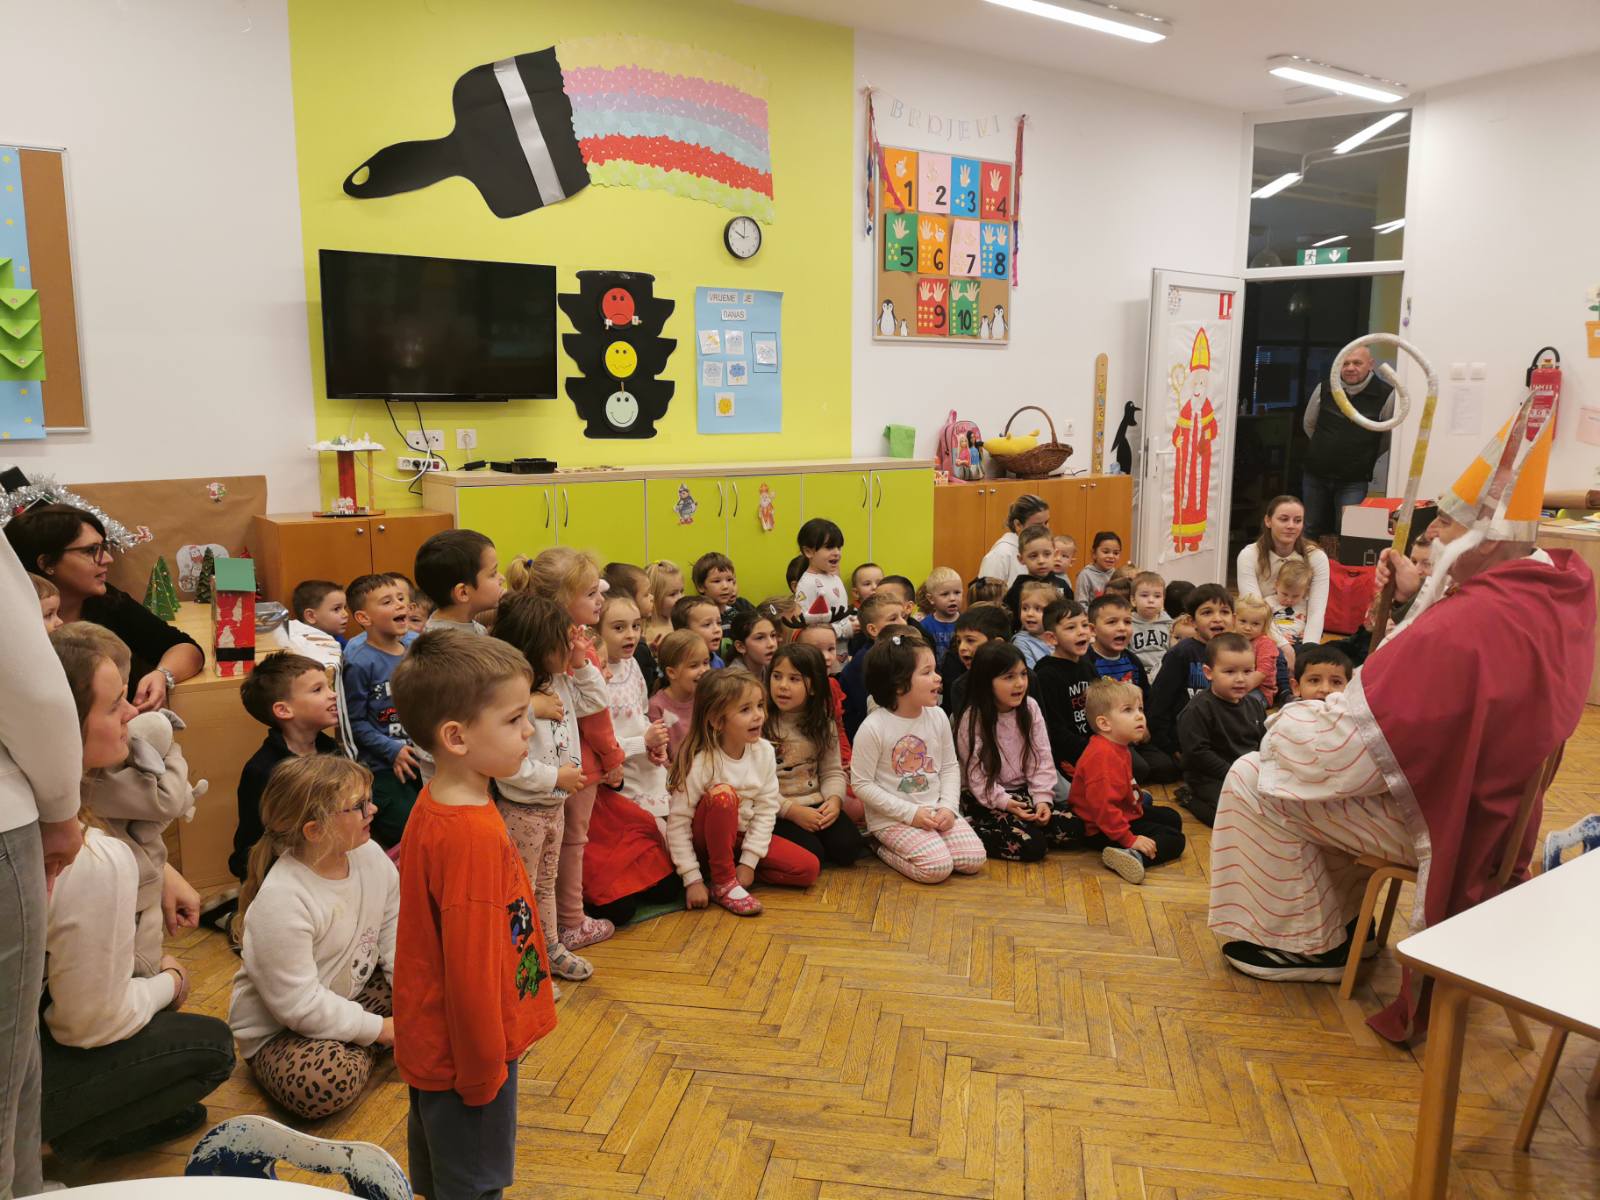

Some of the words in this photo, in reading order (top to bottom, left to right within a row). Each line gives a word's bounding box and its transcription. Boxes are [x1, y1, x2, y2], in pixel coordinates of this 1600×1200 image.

[904, 180, 913, 207] 1
[935, 185, 947, 206] 2
[967, 190, 976, 213] 3
[996, 196, 1007, 218] 4
[900, 246, 914, 267] 5
[933, 248, 944, 271] 6
[966, 254, 976, 274] 7
[994, 252, 1006, 275] 8
[934, 304, 946, 329] 9
[958, 310, 972, 330] 10
[1133, 629, 1168, 650] GAP
